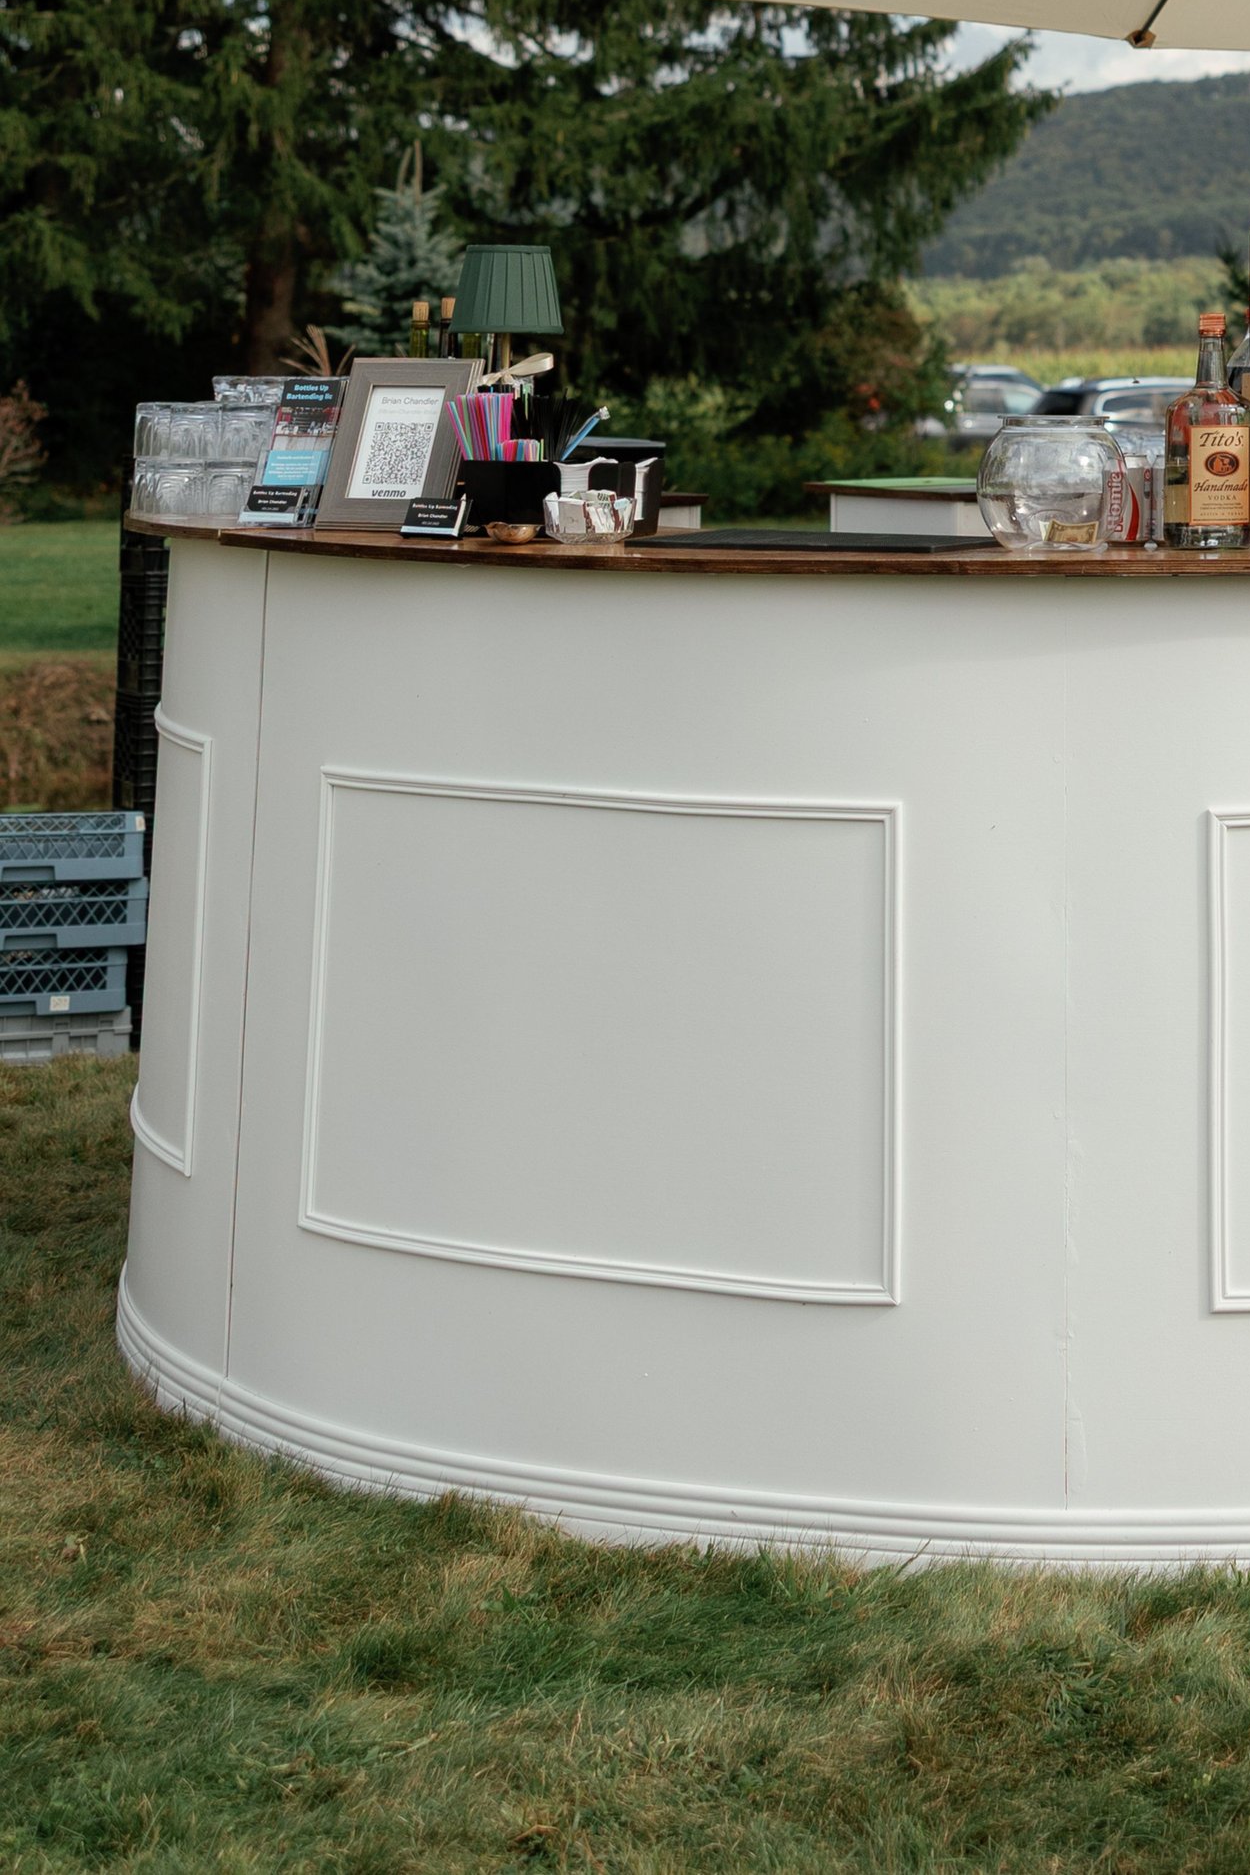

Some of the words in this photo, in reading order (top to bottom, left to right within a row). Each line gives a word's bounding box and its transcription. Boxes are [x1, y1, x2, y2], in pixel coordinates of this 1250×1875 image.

[320, 384, 329, 393] Up
[286, 393, 323, 402] Bartending
[381, 396, 402, 405] Brian
[404, 396, 439, 405] Chandler
[1199, 431, 1244, 447] Tito's
[371, 489, 407, 498] venmo
